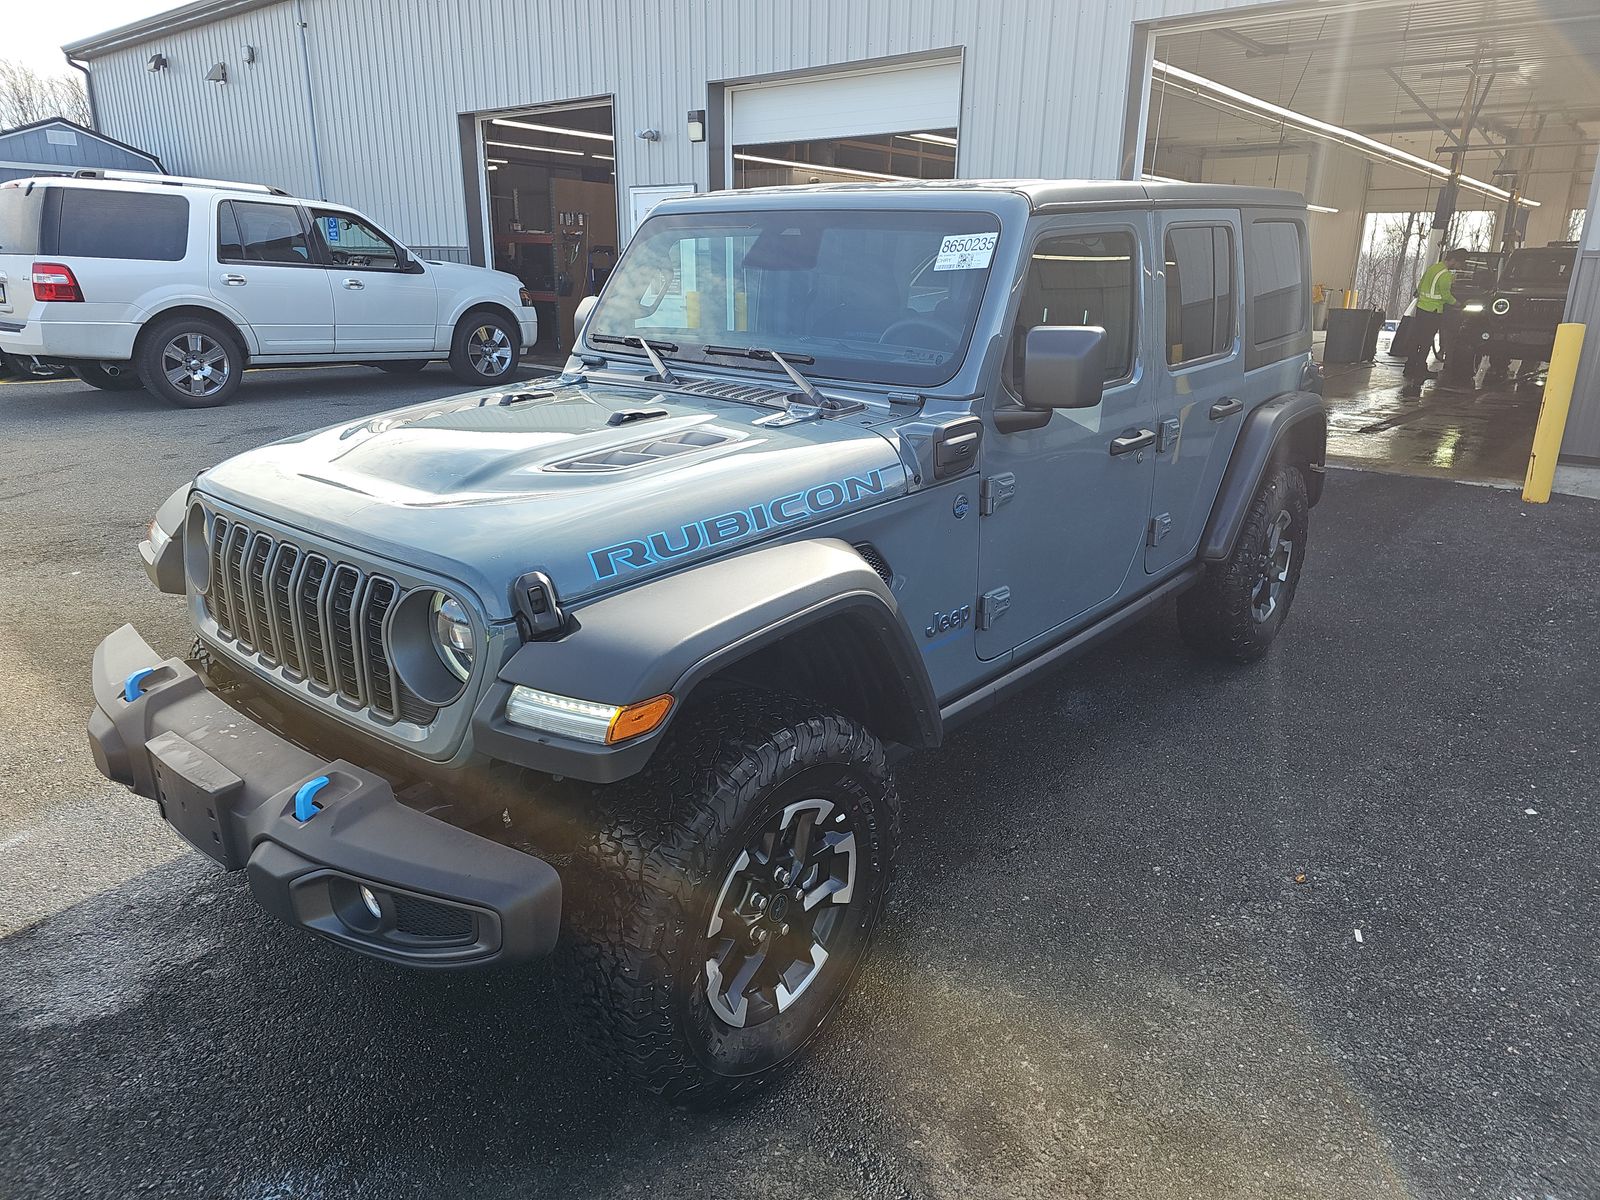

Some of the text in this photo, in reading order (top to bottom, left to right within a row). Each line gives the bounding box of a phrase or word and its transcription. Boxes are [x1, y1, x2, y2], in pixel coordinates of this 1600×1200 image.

[941, 236, 995, 253] 8650235
[587, 469, 884, 580] RUBICON
[925, 604, 971, 638] Jeep
